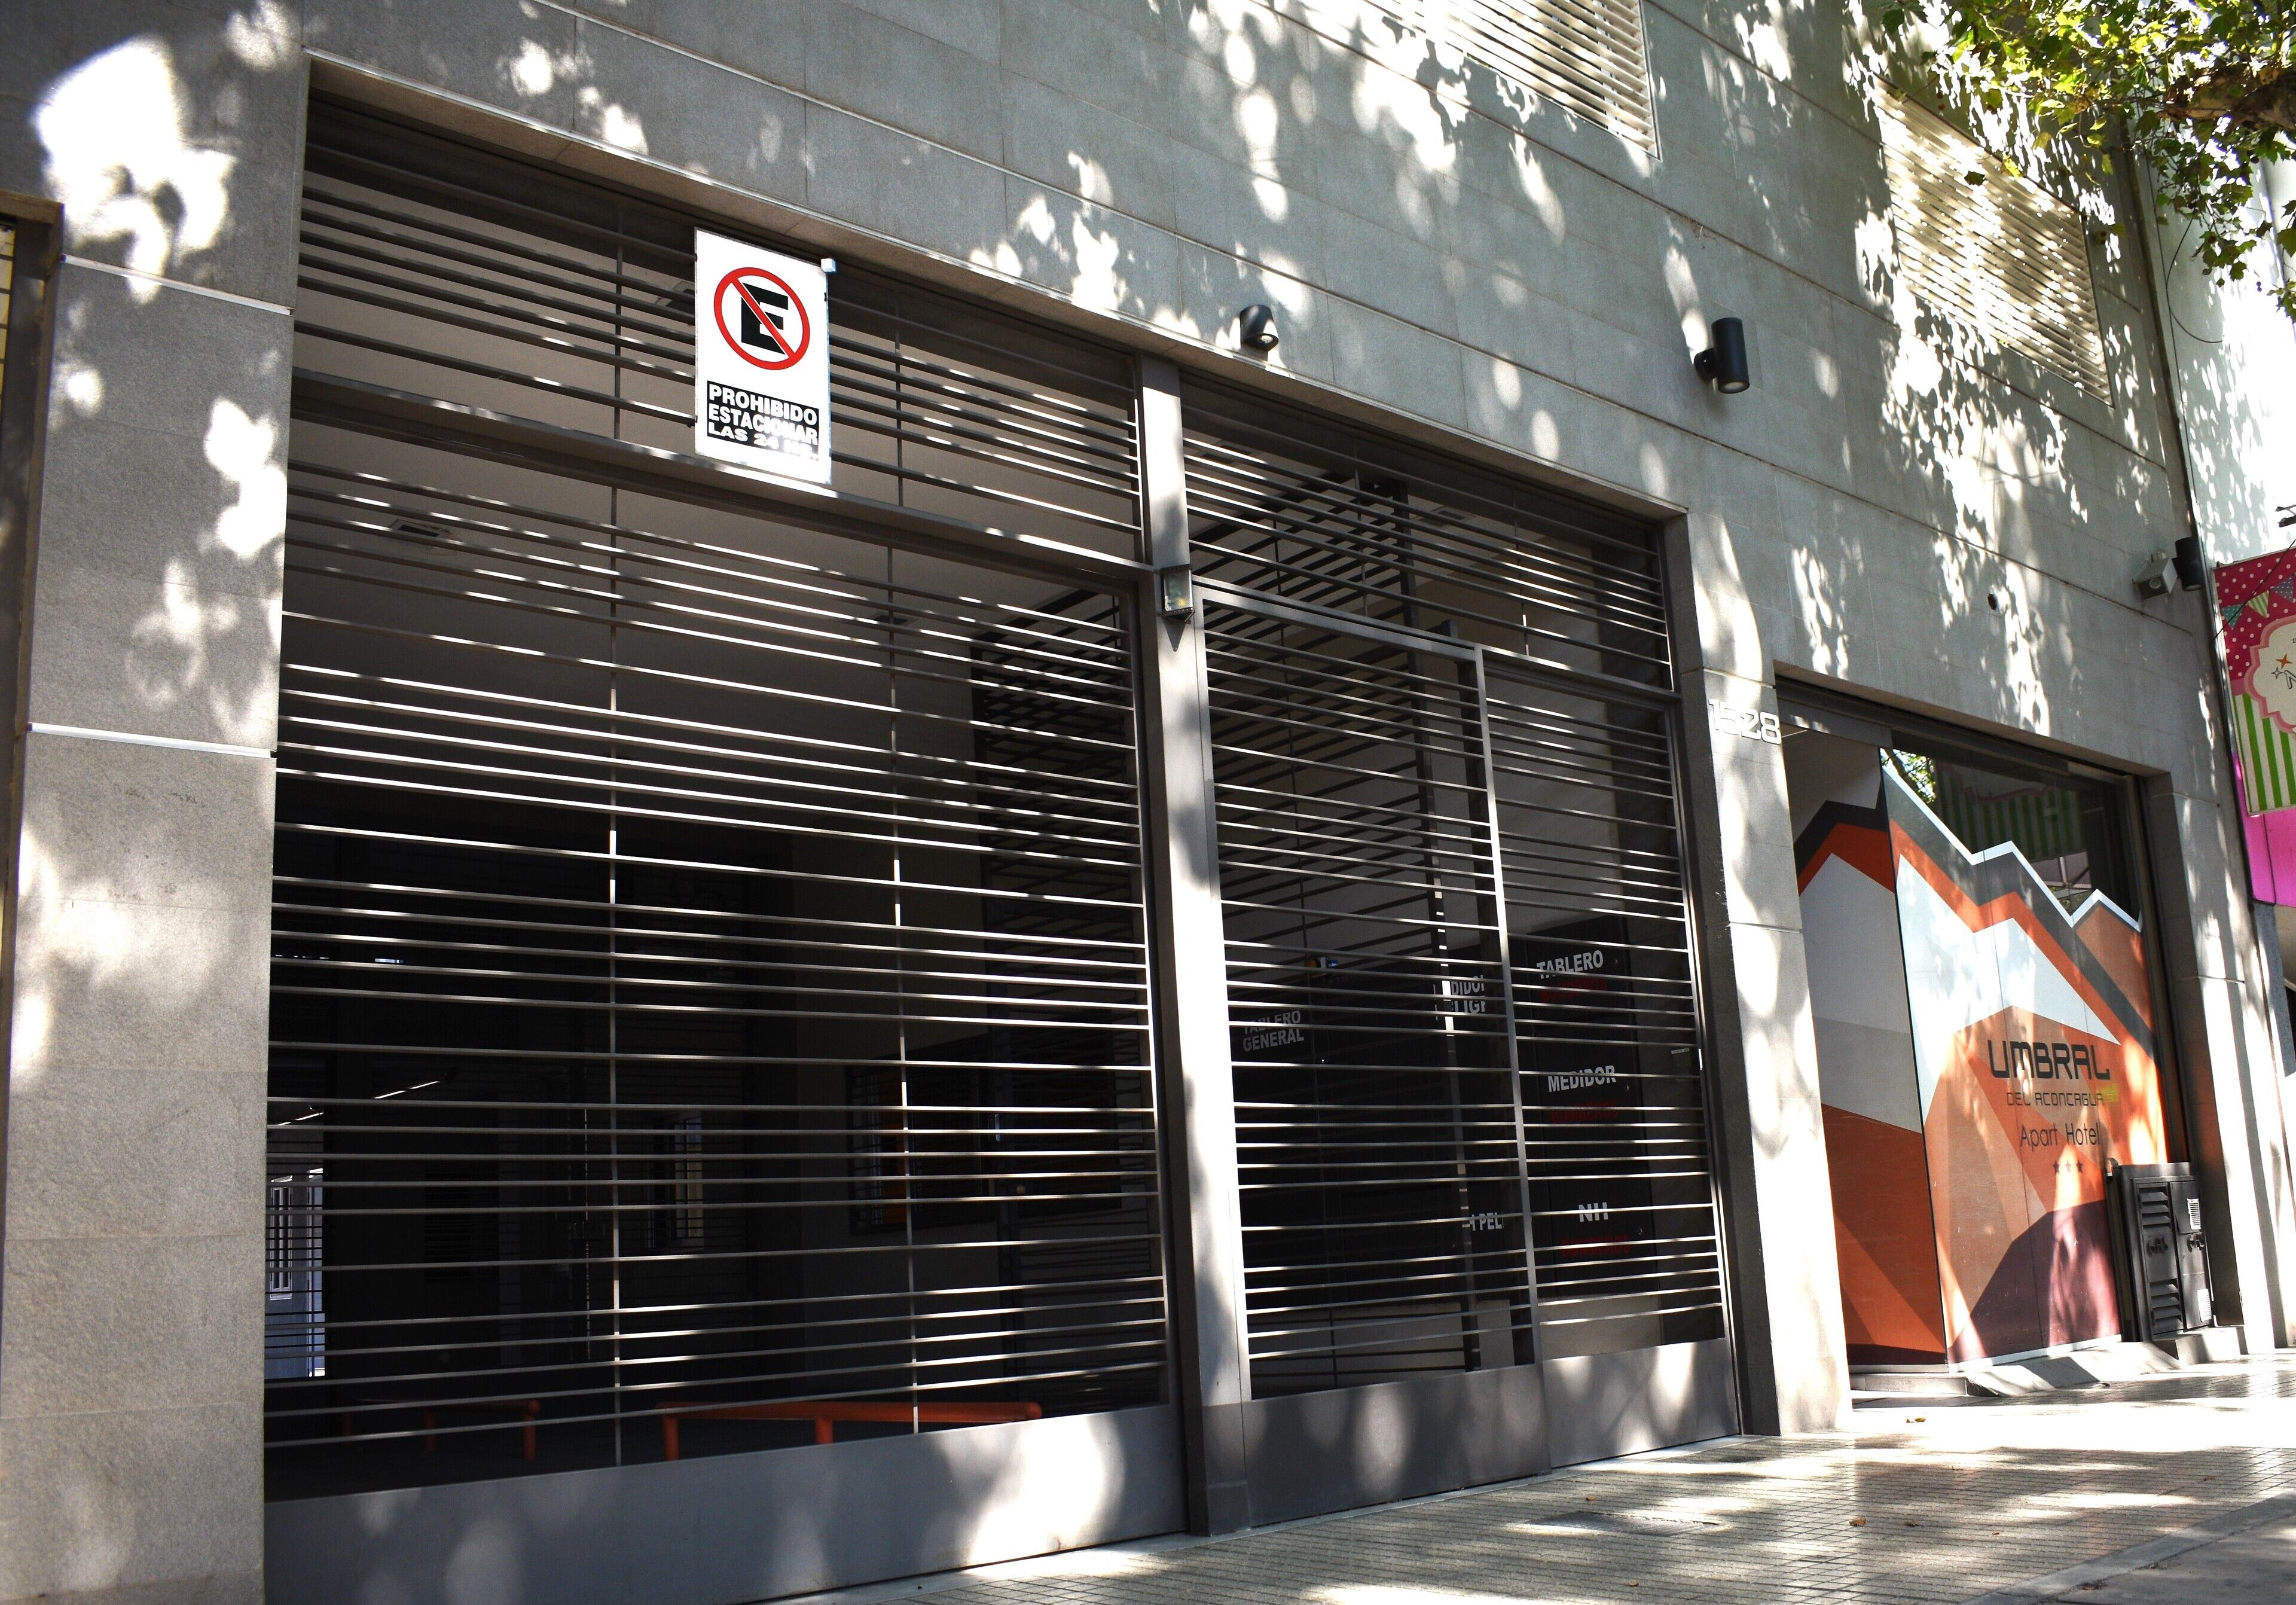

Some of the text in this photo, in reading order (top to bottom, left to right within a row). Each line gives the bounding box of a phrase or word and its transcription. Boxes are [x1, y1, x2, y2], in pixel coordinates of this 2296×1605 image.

[709, 383, 817, 425] PROHIBIDO
[709, 403, 818, 446] ESTACIONAR
[709, 422, 749, 442] LAS
[1708, 698, 1782, 745] 1528
[1537, 950, 1604, 980] TABLERO
[1244, 1028, 1305, 1052] GENERAL
[1987, 1040, 2111, 1080] UMBRAL
[1547, 1065, 1617, 1093] MEDIDOR
[2007, 1092, 2103, 1106] DEL ACONCAGUA
[2020, 1122, 2100, 1152] Apart Hotel
[1578, 1202, 1608, 1222] NH
